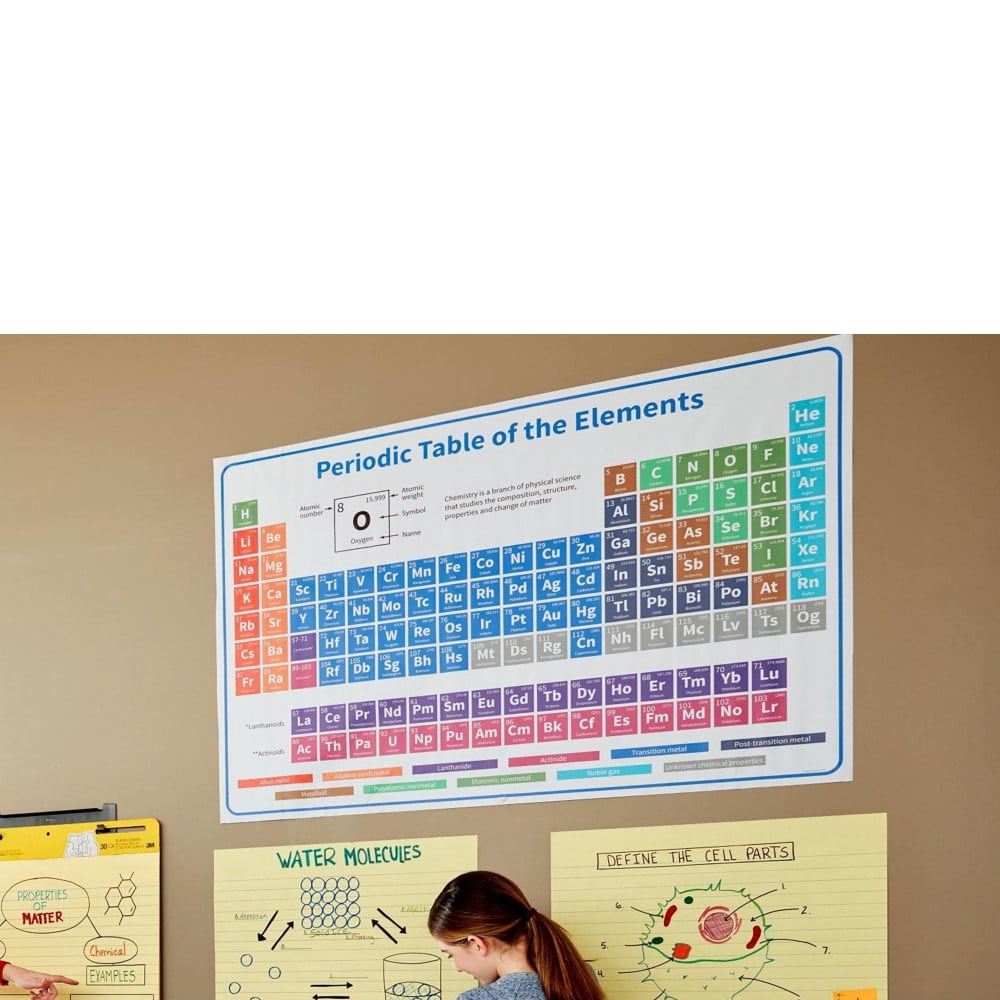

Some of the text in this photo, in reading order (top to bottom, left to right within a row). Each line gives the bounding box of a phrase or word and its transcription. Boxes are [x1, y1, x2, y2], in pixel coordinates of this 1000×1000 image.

[795, 408, 820, 422] He
[317, 391, 704, 479] Periodic Table of the Elements
[764, 449, 772, 460] F
[797, 442, 818, 455] Ne
[725, 455, 736, 466] O
[652, 467, 661, 479] C
[688, 462, 698, 472] N
[616, 474, 626, 485] B
[798, 476, 817, 489] Ar
[402, 485, 424, 493] Atomic
[445, 492, 478, 502] Chemistry
[492, 485, 515, 494] branch
[525, 478, 553, 489] physical
[555, 474, 581, 483] science
[762, 481, 776, 494] Cl
[402, 493, 423, 501] weight
[460, 501, 483, 509] studies
[497, 490, 541, 502] composition,
[543, 485, 576, 494] structure,
[337, 503, 344, 512] 8
[402, 507, 426, 517] Symbol
[445, 510, 478, 520] properties
[494, 503, 518, 512] change
[528, 497, 552, 506] matter
[613, 505, 628, 517] Al
[240, 508, 249, 520] H
[300, 511, 323, 519] number
[353, 511, 370, 530] O
[760, 514, 778, 527] Br
[721, 521, 740, 533] Se
[240, 536, 250, 548] Li
[351, 536, 373, 544] Oxygen
[611, 538, 630, 550] Ga
[576, 542, 594, 555] Zn
[798, 544, 818, 556] Xe
[511, 552, 525, 564] Ni
[239, 564, 254, 576] Na
[265, 559, 283, 574] Mg
[413, 566, 431, 578] Mn
[446, 562, 461, 573] Fe
[798, 576, 819, 590] Rn
[267, 589, 282, 600] Ca
[296, 584, 310, 596] Sc
[721, 586, 741, 600] Po
[382, 600, 401, 612] Mo
[647, 596, 667, 608] Pb
[577, 605, 596, 619] Hg
[797, 610, 820, 625] Og
[325, 637, 339, 649] Hf
[241, 649, 254, 660] Cs
[721, 672, 741, 684] Yb
[760, 667, 779, 681] Lu
[682, 676, 705, 688] Tm
[478, 697, 495, 708] Eu
[510, 693, 528, 705] Gd
[384, 705, 401, 718] Nd
[721, 704, 742, 717] No
[762, 701, 777, 714] Lr
[297, 715, 311, 727] La
[388, 735, 397, 747] U
[734, 738, 788, 748] Post-transition
[437, 763, 472, 772] Lanthanide
[665, 757, 764, 771] Unknown chemical properties
[277, 845, 421, 869] WATER MOLECULES
[607, 845, 789, 867] DEFINE THE CELL PARTS
[17, 889, 68, 901] PROPERTIES
[33, 901, 47, 911] OF
[22, 911, 64, 925] MATTER
[90, 942, 126, 957] Chemical
[90, 970, 136, 983] EXAMPLES
